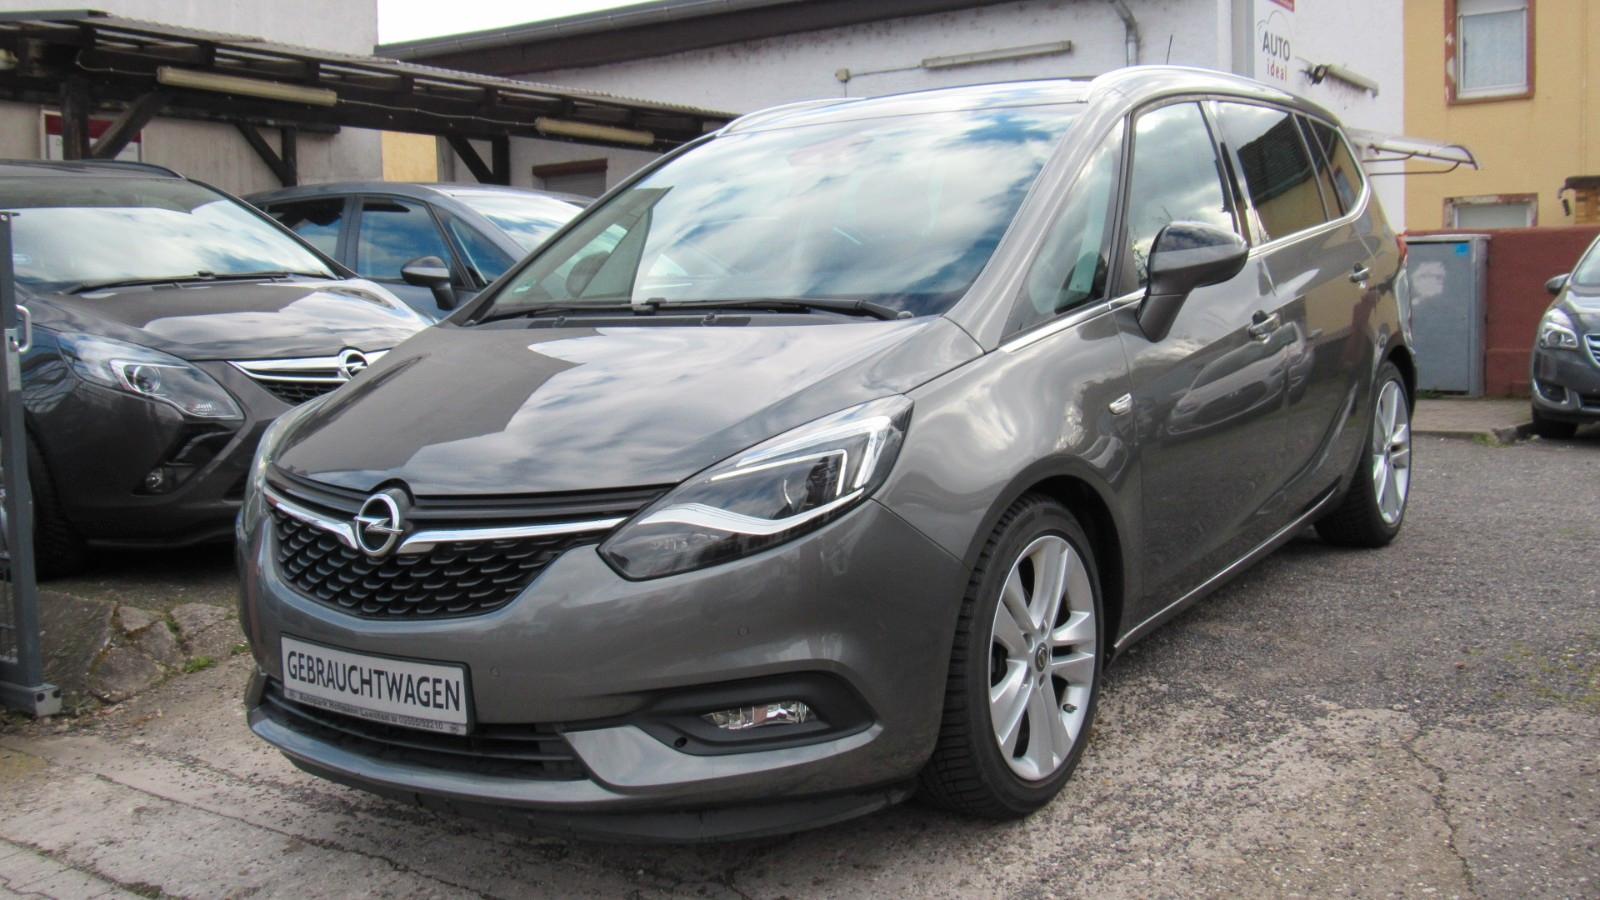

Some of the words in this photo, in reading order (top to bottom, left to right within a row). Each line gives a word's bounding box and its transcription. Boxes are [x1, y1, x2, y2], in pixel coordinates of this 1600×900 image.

[1262, 31, 1290, 61] AUTO
[1266, 58, 1287, 81] ideal
[287, 650, 460, 711] GEBRAUCHTWAGEN
